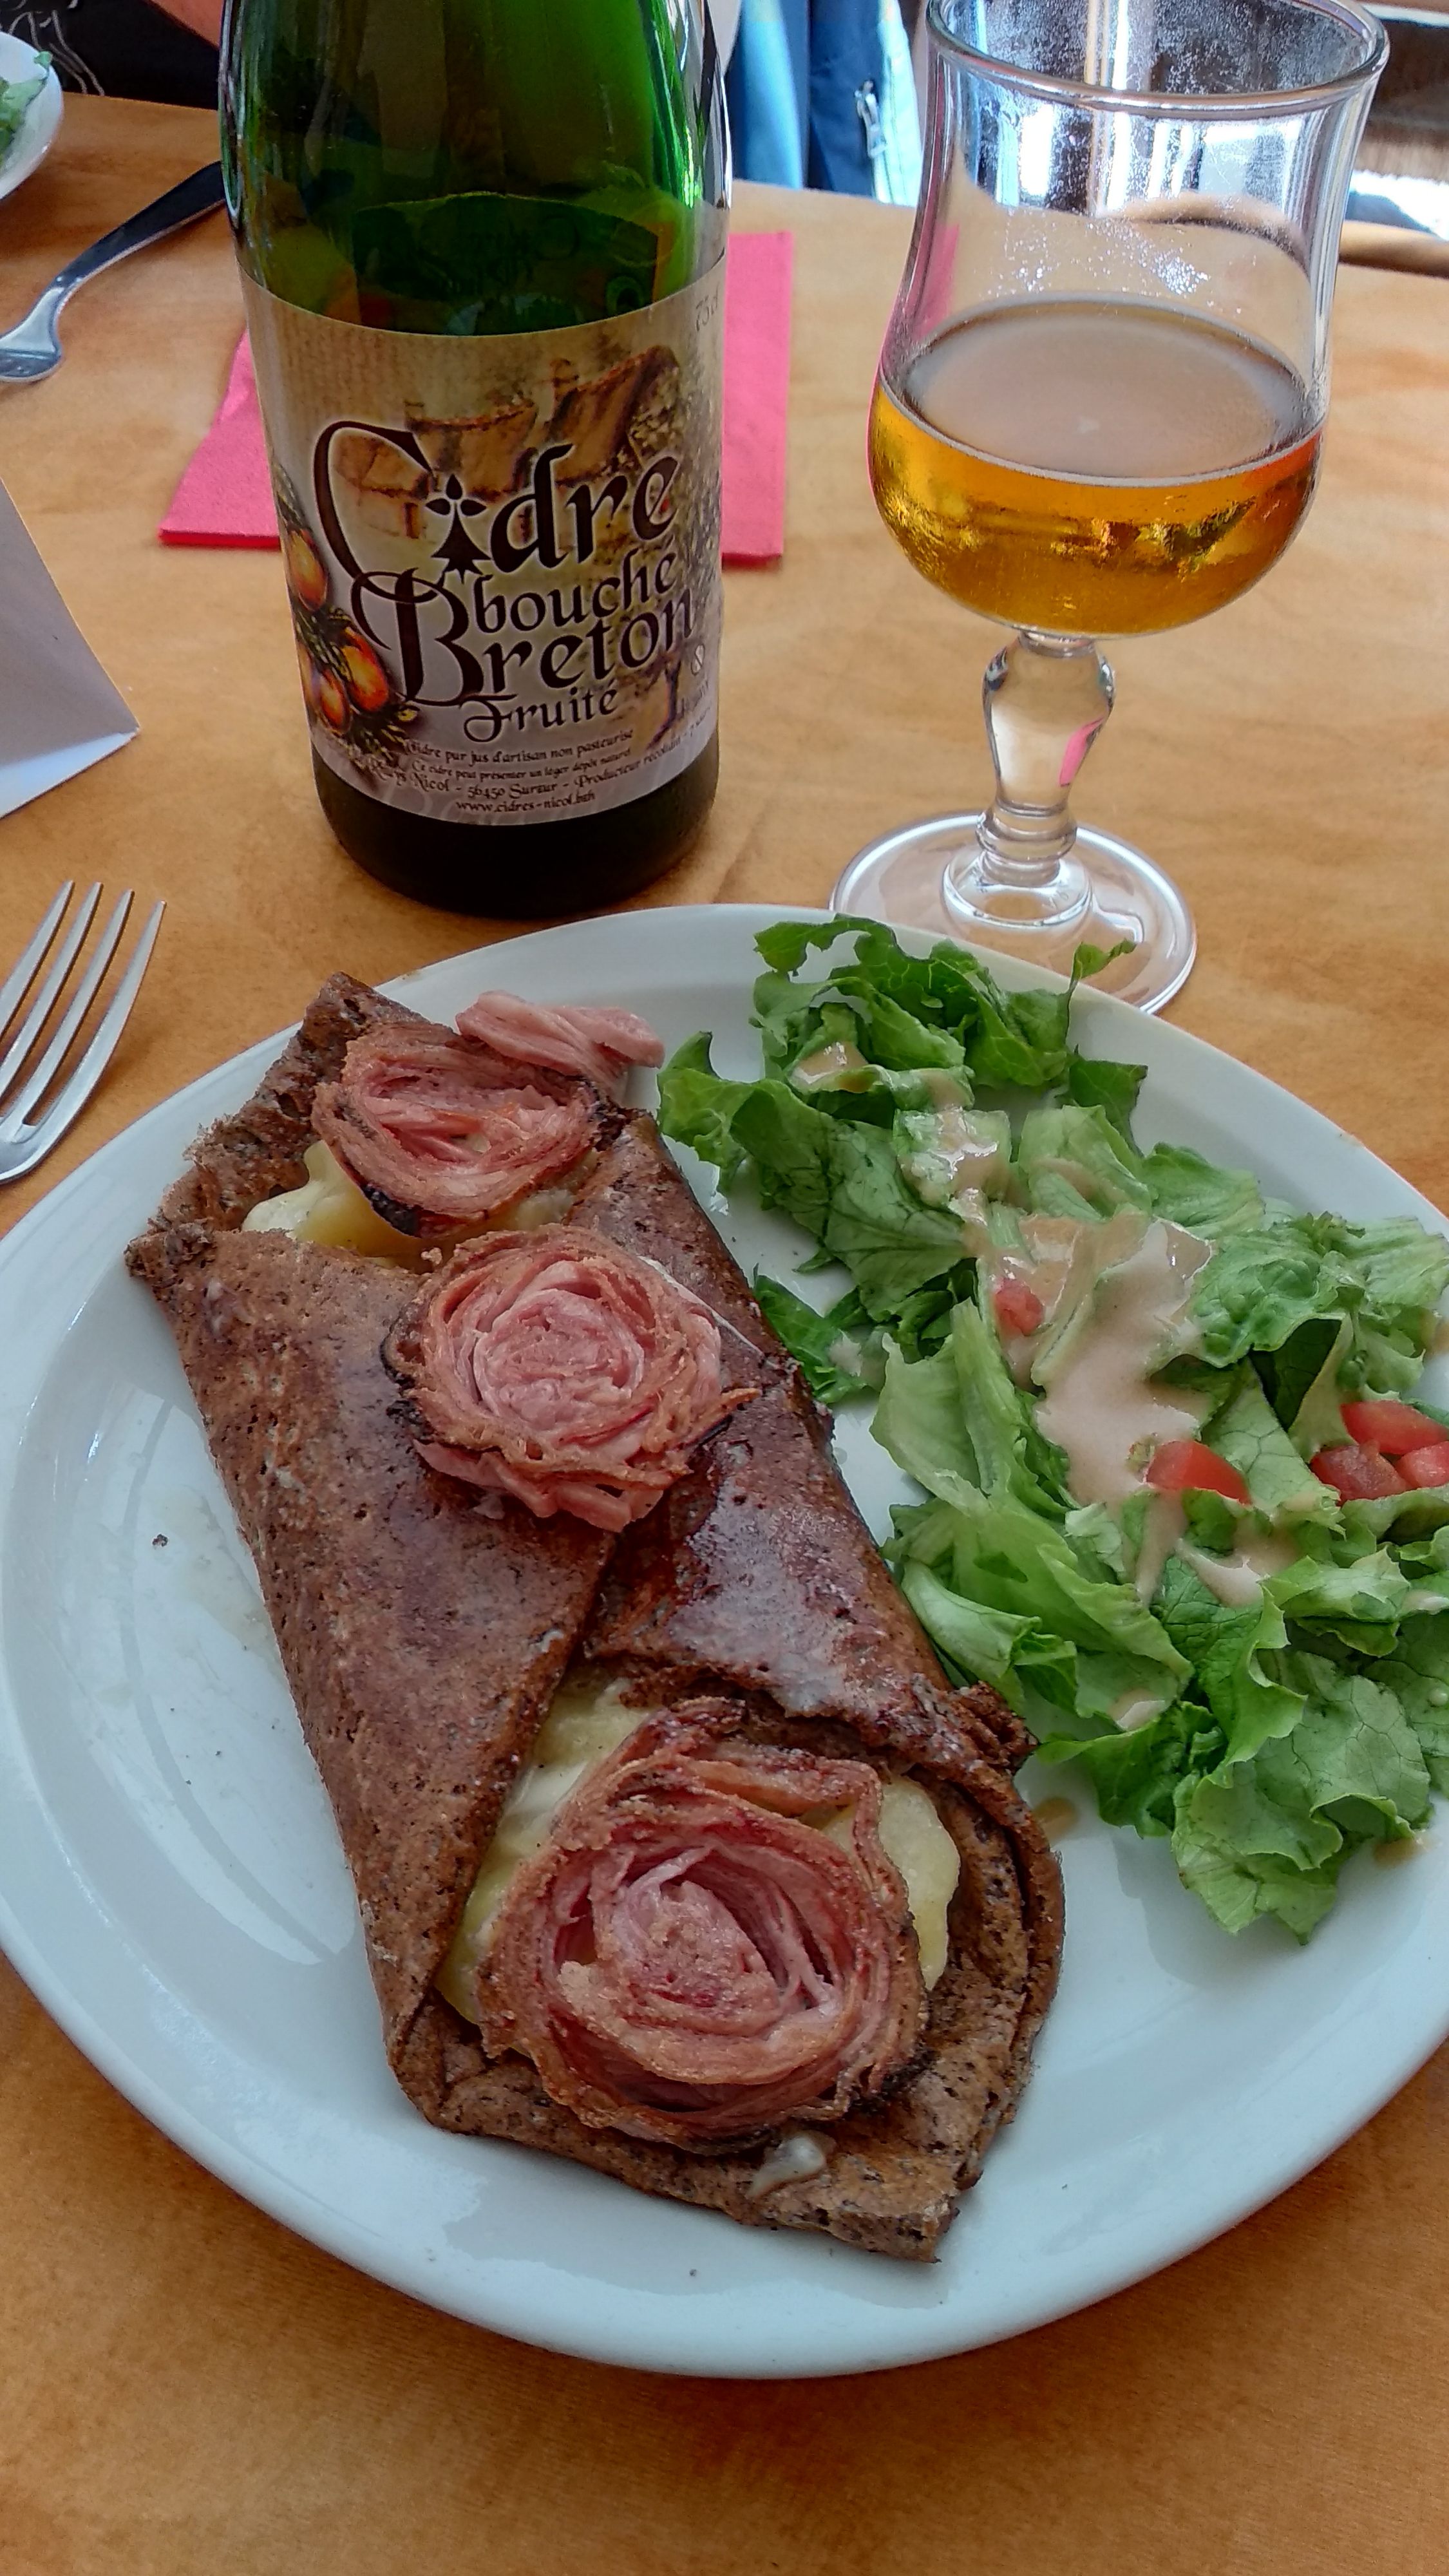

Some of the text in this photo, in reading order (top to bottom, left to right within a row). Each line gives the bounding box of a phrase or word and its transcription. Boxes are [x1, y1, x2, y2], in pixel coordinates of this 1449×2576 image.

[313, 421, 680, 604] Cidre
[351, 568, 693, 706] Breton
[463, 678, 619, 743] Fruité
[407, 741, 442, 758] Cidre
[445, 751, 468, 764] pur
[469, 751, 489, 766] jus
[551, 748, 573, 757] non
[412, 759, 426, 772] Ce
[409, 771, 451, 792] Nicol
[468, 784, 506, 800] 56450
[574, 760, 641, 788] Producteur
